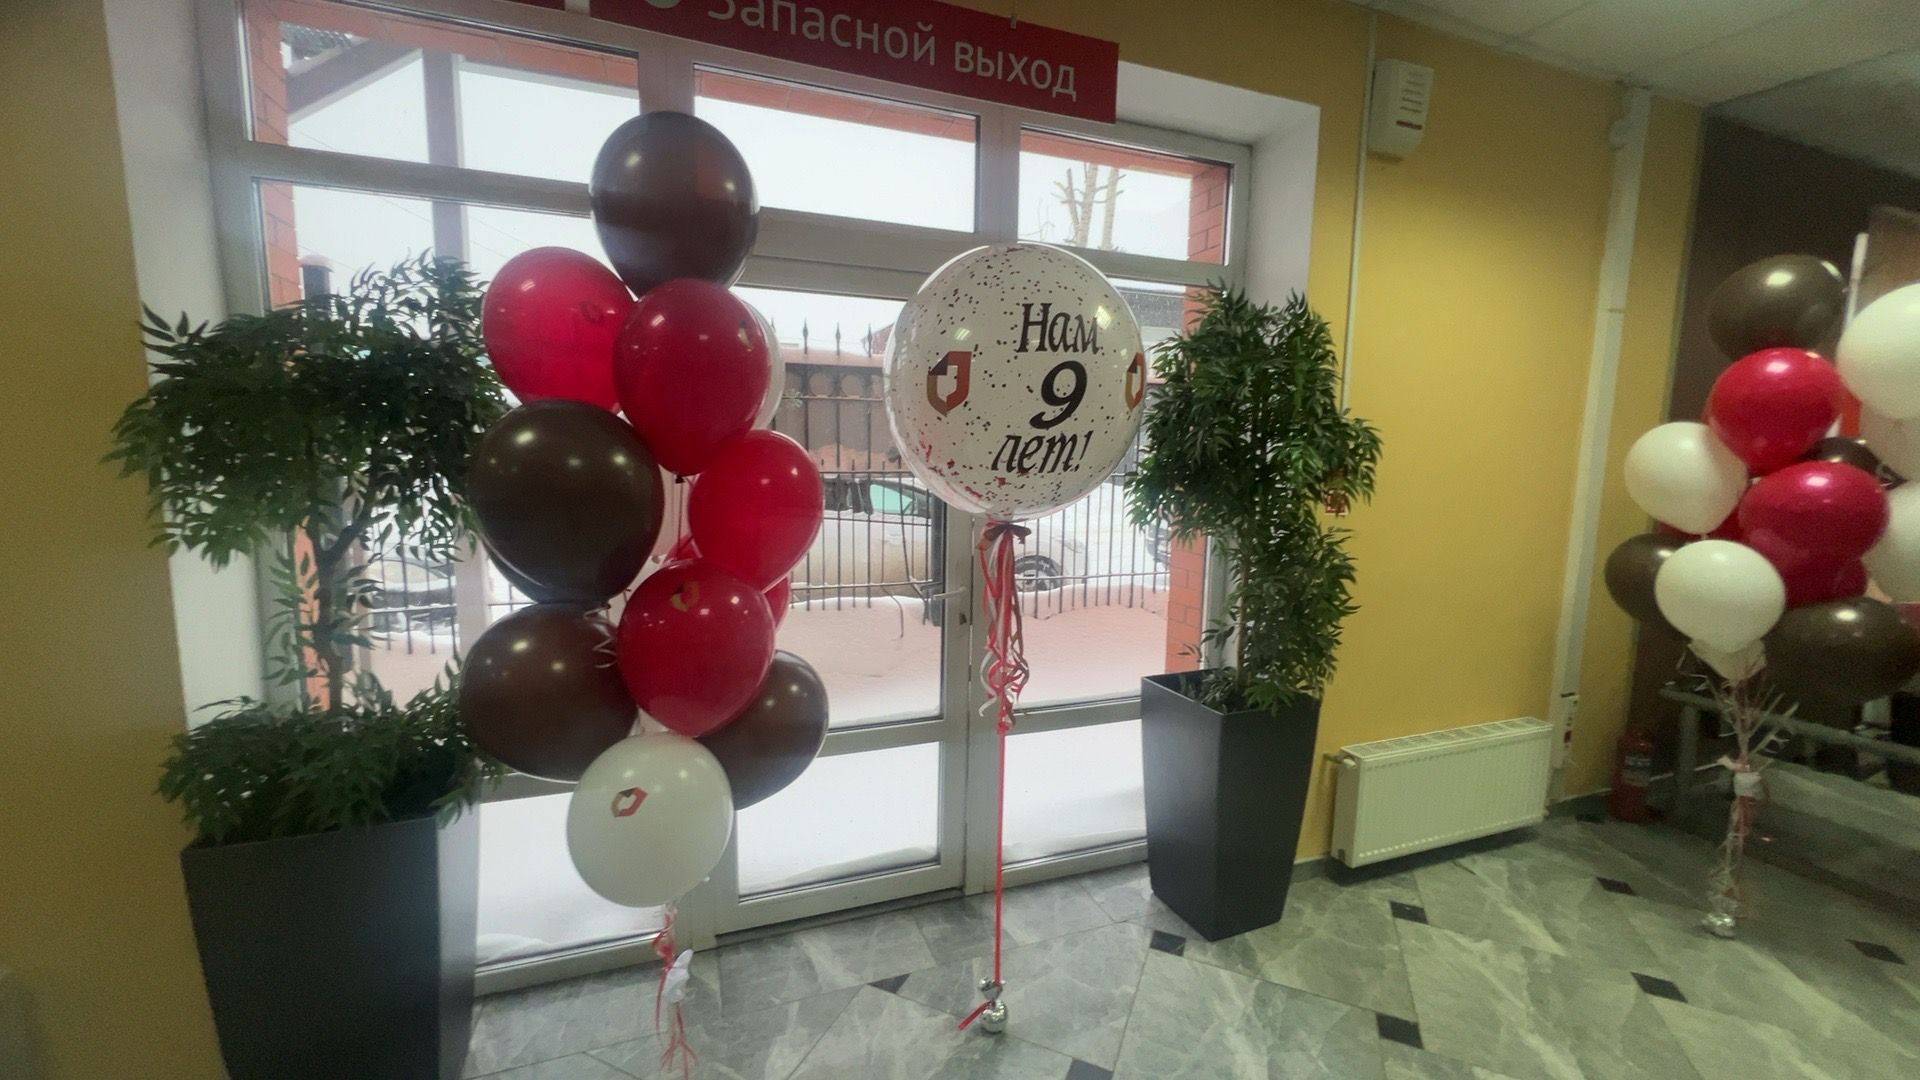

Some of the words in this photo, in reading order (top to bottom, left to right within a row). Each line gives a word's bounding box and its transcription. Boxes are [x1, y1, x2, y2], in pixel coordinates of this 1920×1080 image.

[954, 41, 1077, 102] выход
[1015, 303, 1102, 354] Нам
[1029, 360, 1087, 430] 9
[991, 430, 1094, 474] лет!
